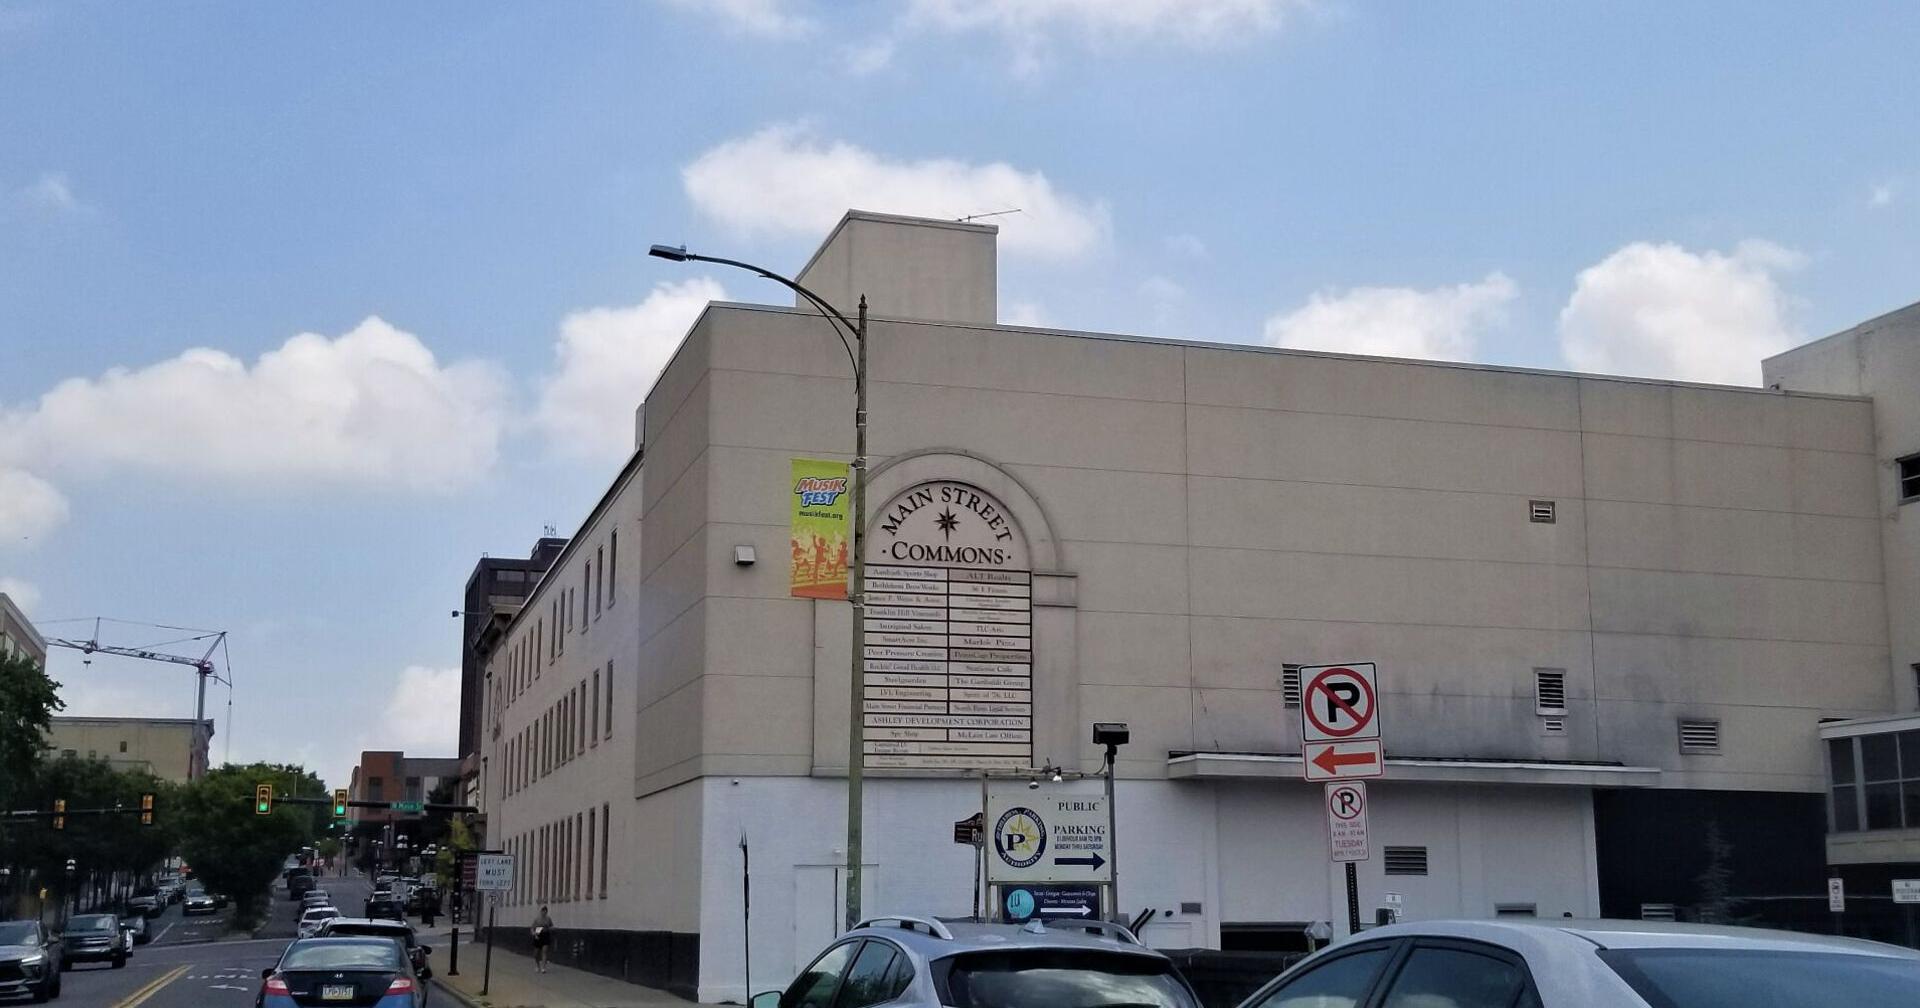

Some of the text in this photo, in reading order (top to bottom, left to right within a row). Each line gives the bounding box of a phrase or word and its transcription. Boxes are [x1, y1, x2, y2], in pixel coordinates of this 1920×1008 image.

[797, 478, 846, 494] MUSIK
[802, 491, 838, 505] FEST
[799, 510, 843, 520] musikfest.org
[881, 486, 1013, 542] MAIN STREET
[891, 541, 1004, 564] COMMONS
[905, 717, 964, 725] DEVELOPMENT
[967, 718, 1024, 726] CORPORATION
[1058, 802, 1101, 812] PUBLIC
[1023, 810, 1046, 838] PARKING
[1054, 825, 1106, 835] PARKING
[1006, 834, 1026, 851] P
[1335, 839, 1364, 848] TUESDAY
[1000, 852, 1041, 867] AUTHORITY
[485, 868, 505, 876] MUST
